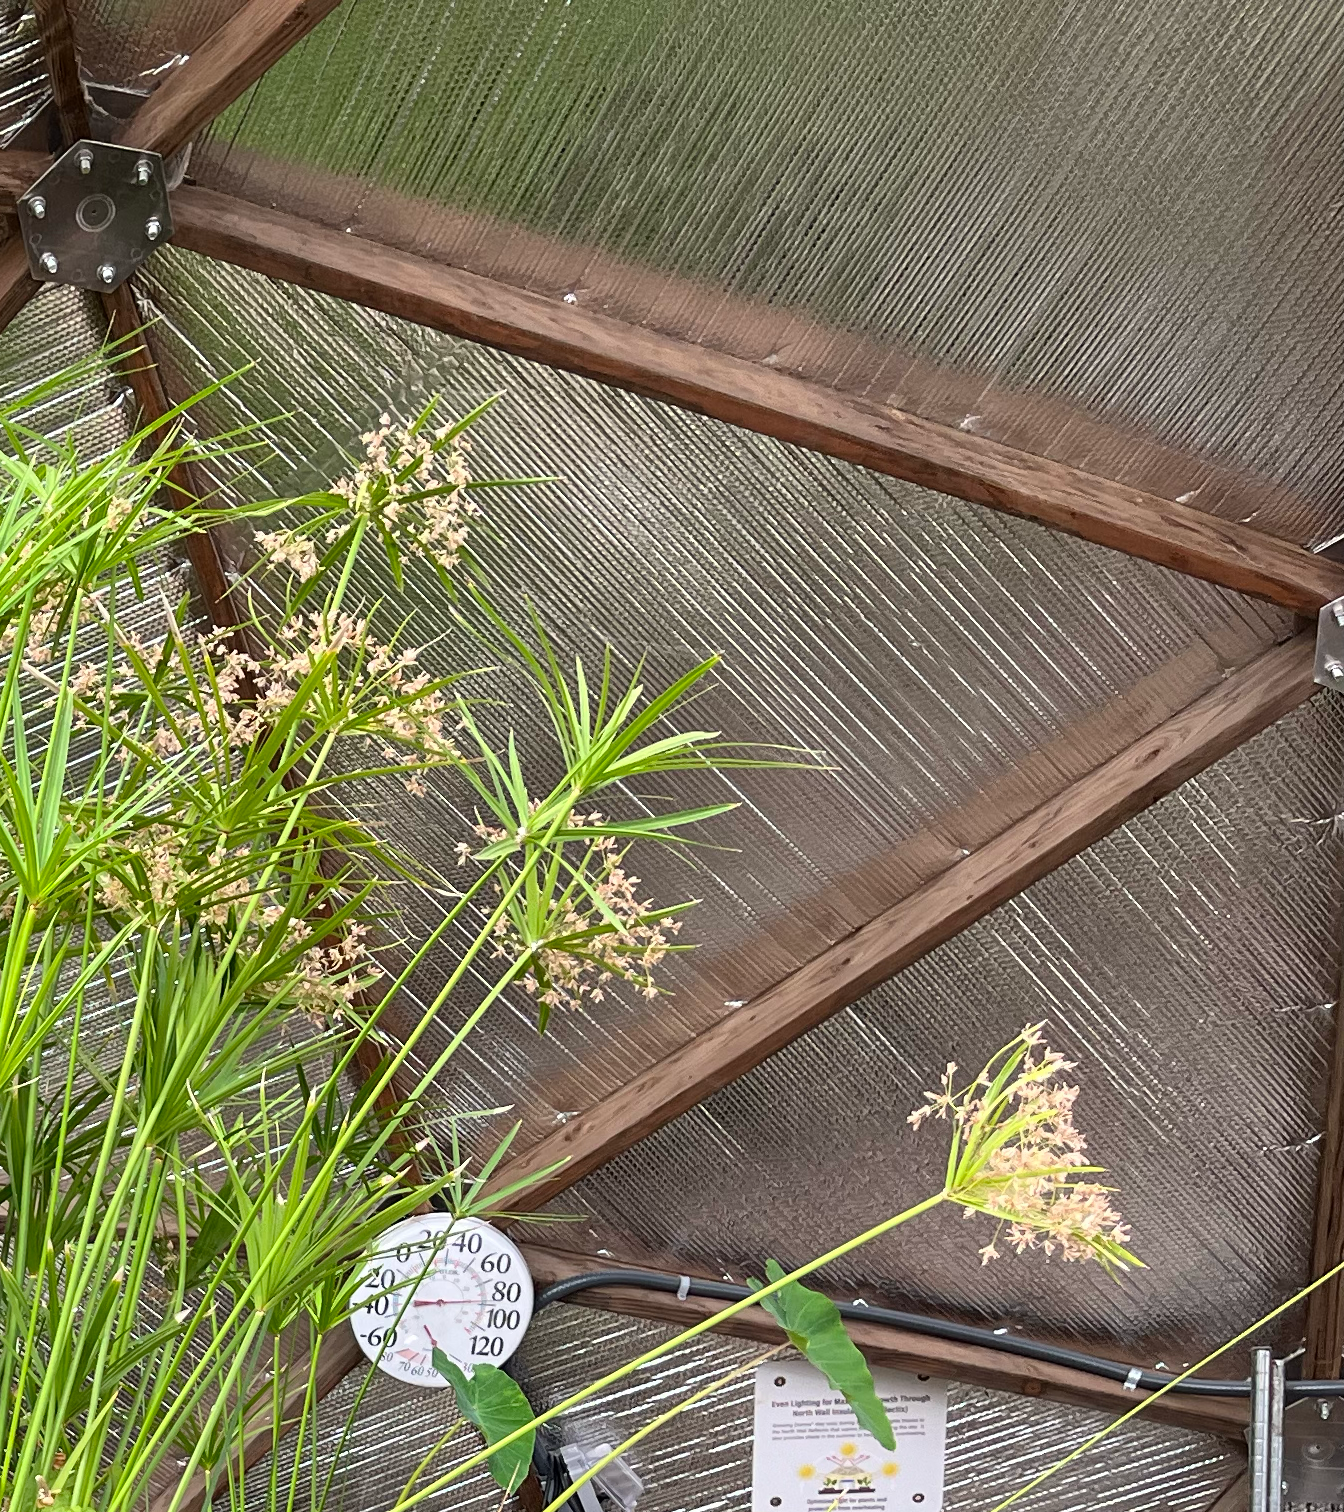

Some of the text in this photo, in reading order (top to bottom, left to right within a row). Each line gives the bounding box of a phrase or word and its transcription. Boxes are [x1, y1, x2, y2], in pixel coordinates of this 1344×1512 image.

[452, 1232, 482, 1254] 40
[481, 1252, 511, 1273] 60
[492, 1281, 521, 1303] 80
[487, 1308, 520, 1330] 100
[360, 1326, 397, 1348] -60
[471, 1335, 504, 1356] 120
[399, 1361, 411, 1372] 70
[410, 1366, 424, 1376] 60
[425, 1368, 439, 1378] 50
